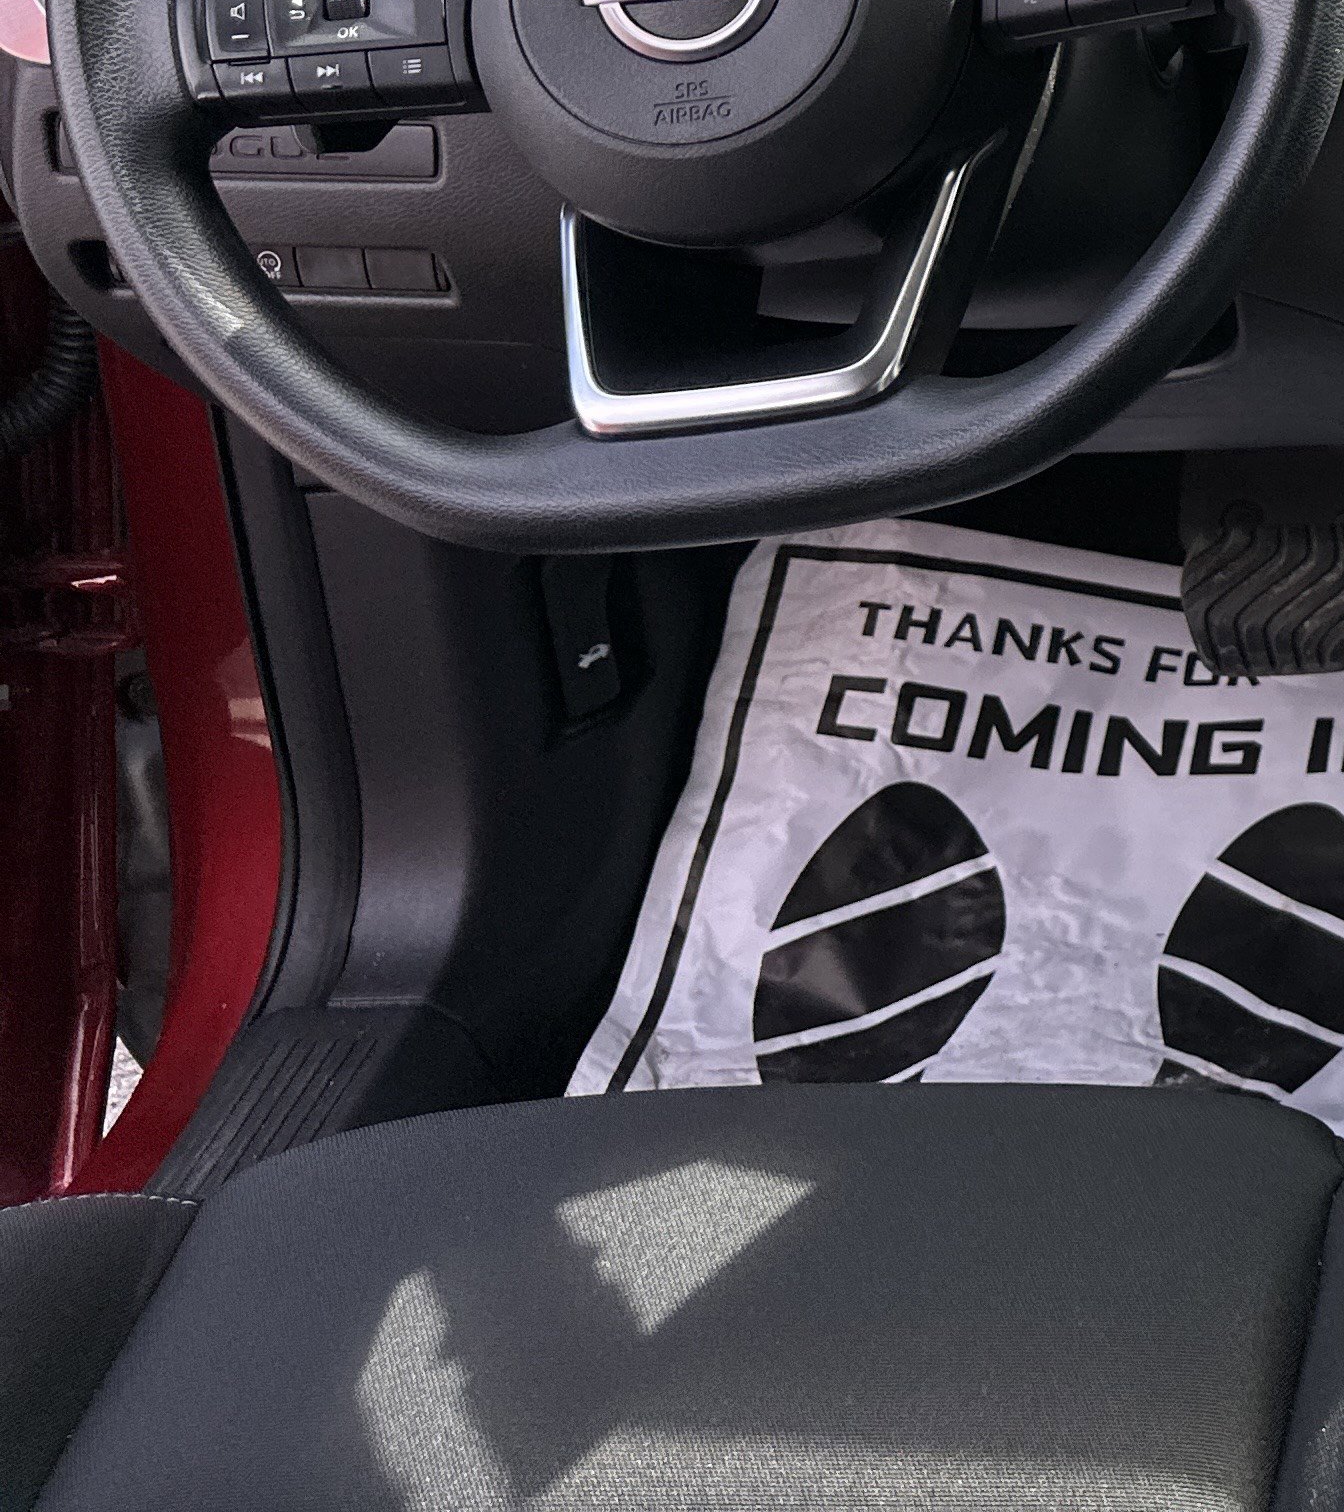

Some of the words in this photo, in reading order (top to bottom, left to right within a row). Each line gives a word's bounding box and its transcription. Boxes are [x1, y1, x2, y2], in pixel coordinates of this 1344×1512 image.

[337, 25, 359, 39] OK
[674, 81, 709, 100] SRS
[653, 102, 731, 127] AIRBAG
[858, 600, 1126, 674] THANKS
[815, 674, 1264, 777] COMING
